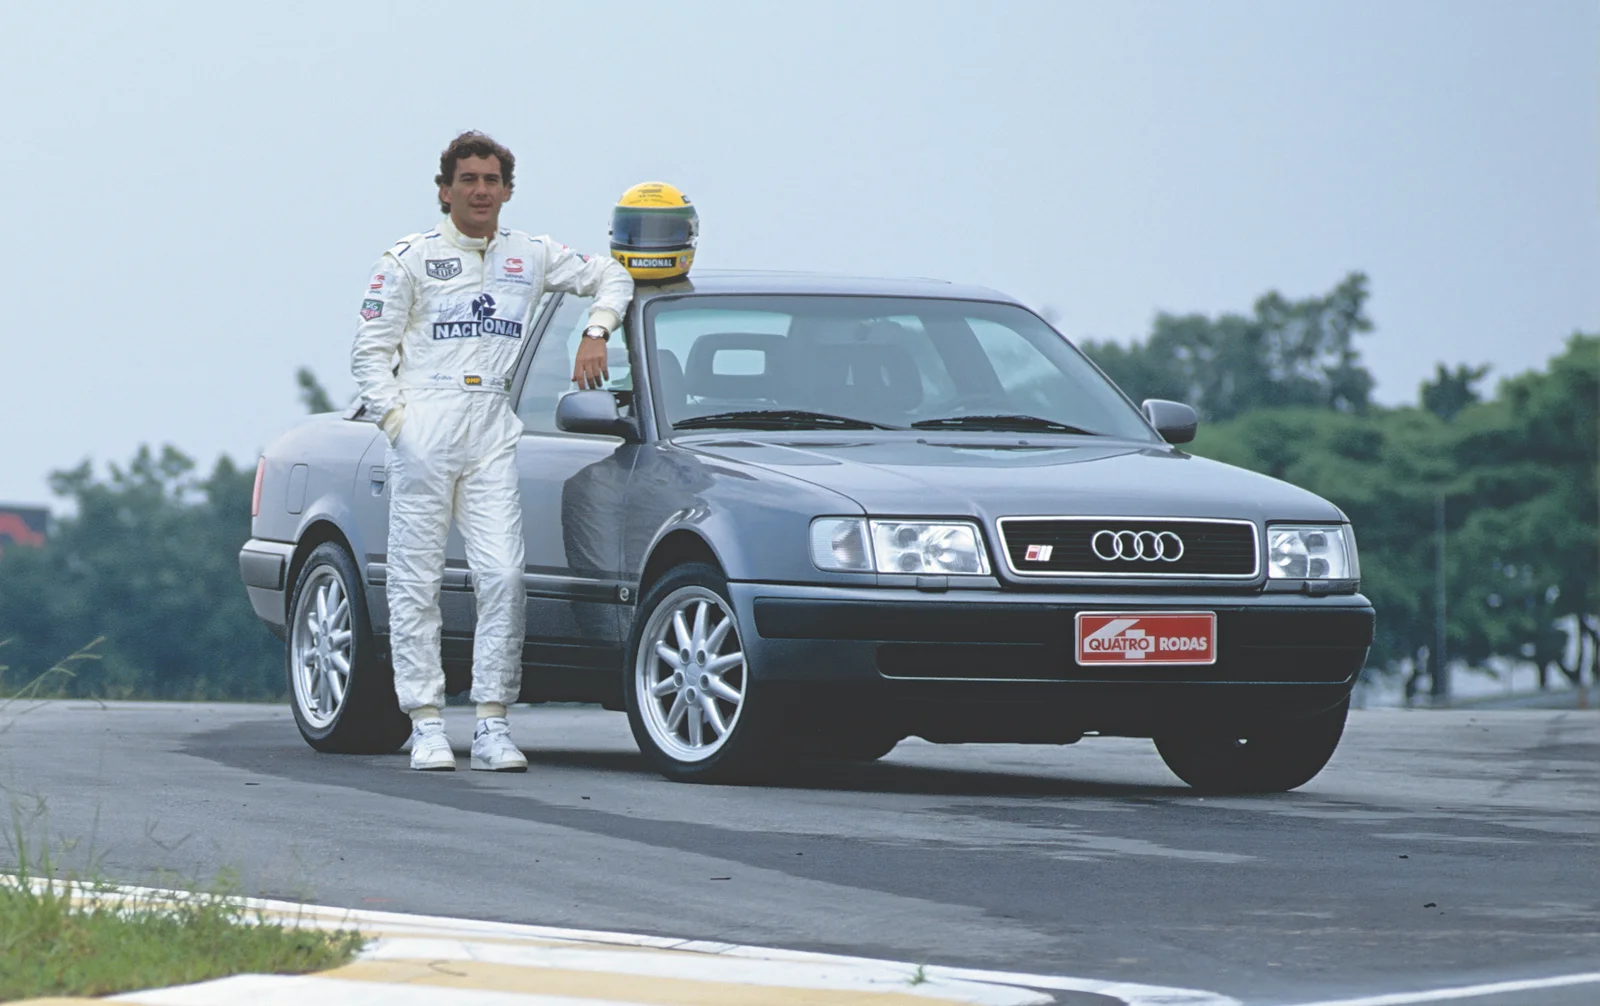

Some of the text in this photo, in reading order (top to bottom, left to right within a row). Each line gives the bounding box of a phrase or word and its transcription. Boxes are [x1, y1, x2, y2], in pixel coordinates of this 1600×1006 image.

[631, 258, 672, 267] NACIONAL
[435, 318, 519, 339] NACIONAL
[1088, 636, 1208, 651] QUATRO RODAS
